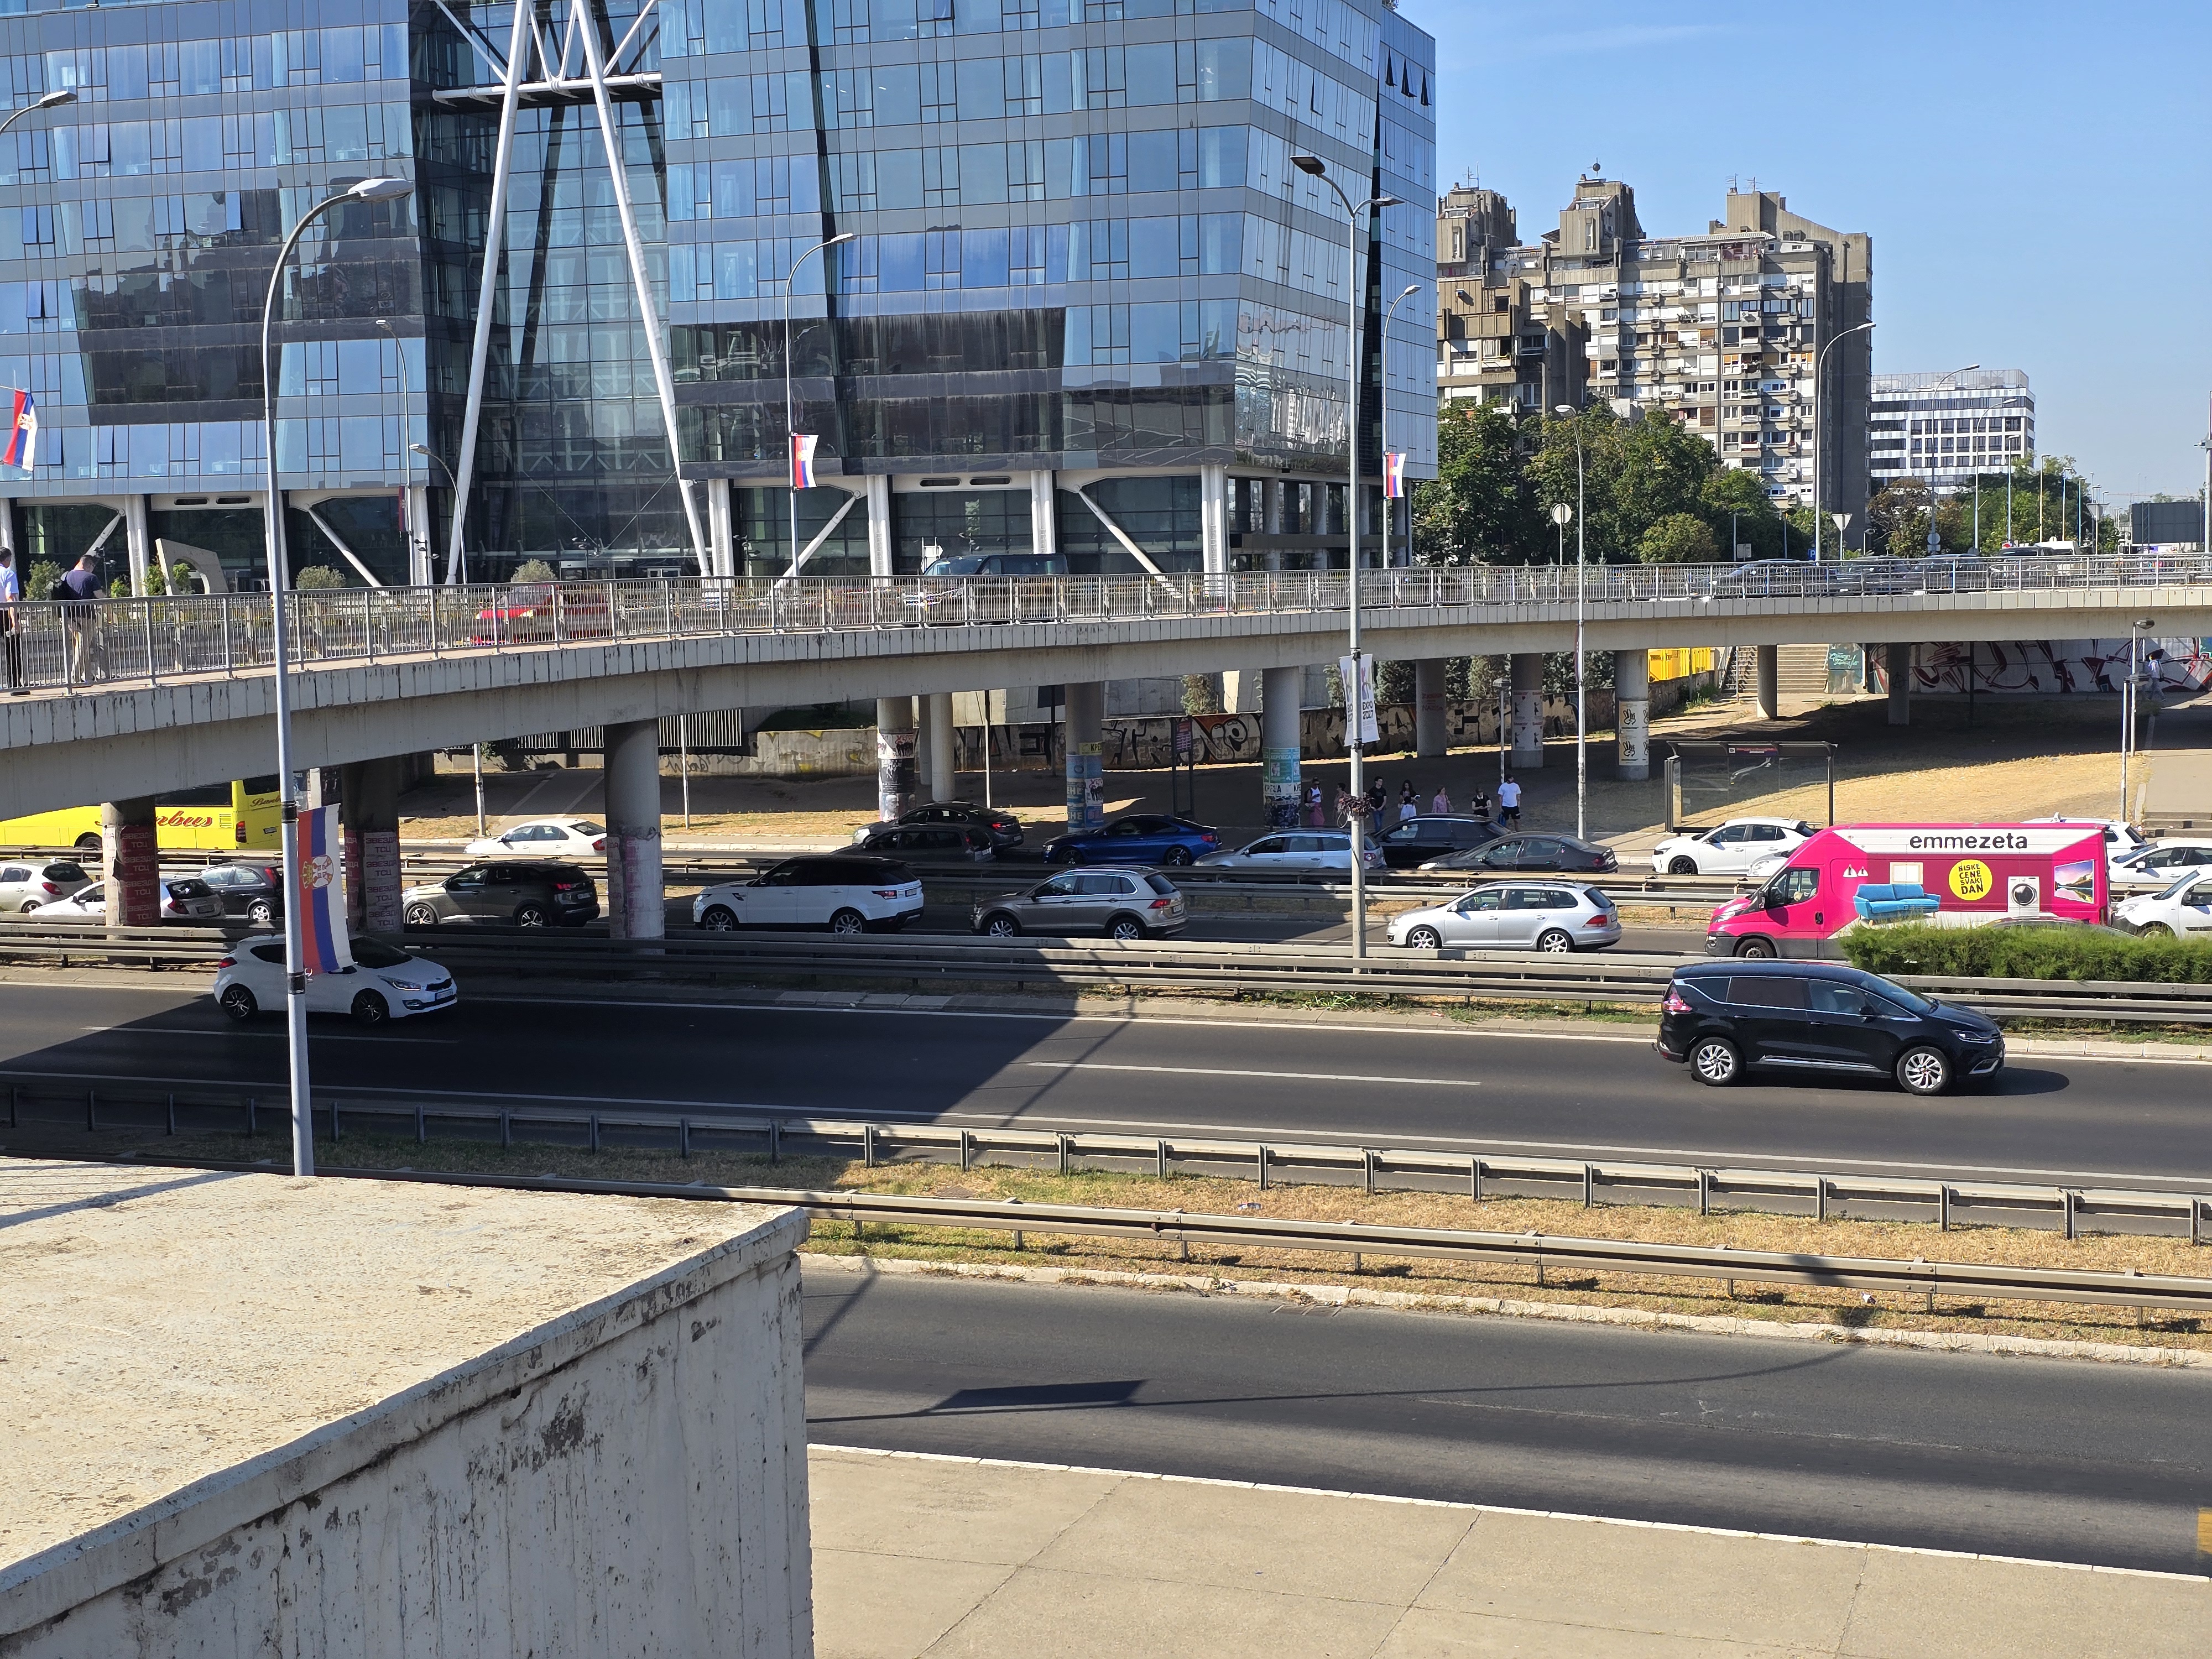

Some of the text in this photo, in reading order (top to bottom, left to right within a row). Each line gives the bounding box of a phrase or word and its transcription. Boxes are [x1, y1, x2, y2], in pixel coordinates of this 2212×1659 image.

[1363, 710, 1374, 719] 2027
[1910, 832, 2027, 849] emmezeta
[1958, 863, 1980, 872] NISKE
[1959, 870, 1981, 879] CENE
[1961, 884, 1983, 894] DAN
[368, 910, 399, 918] ЗВЕЗДА
